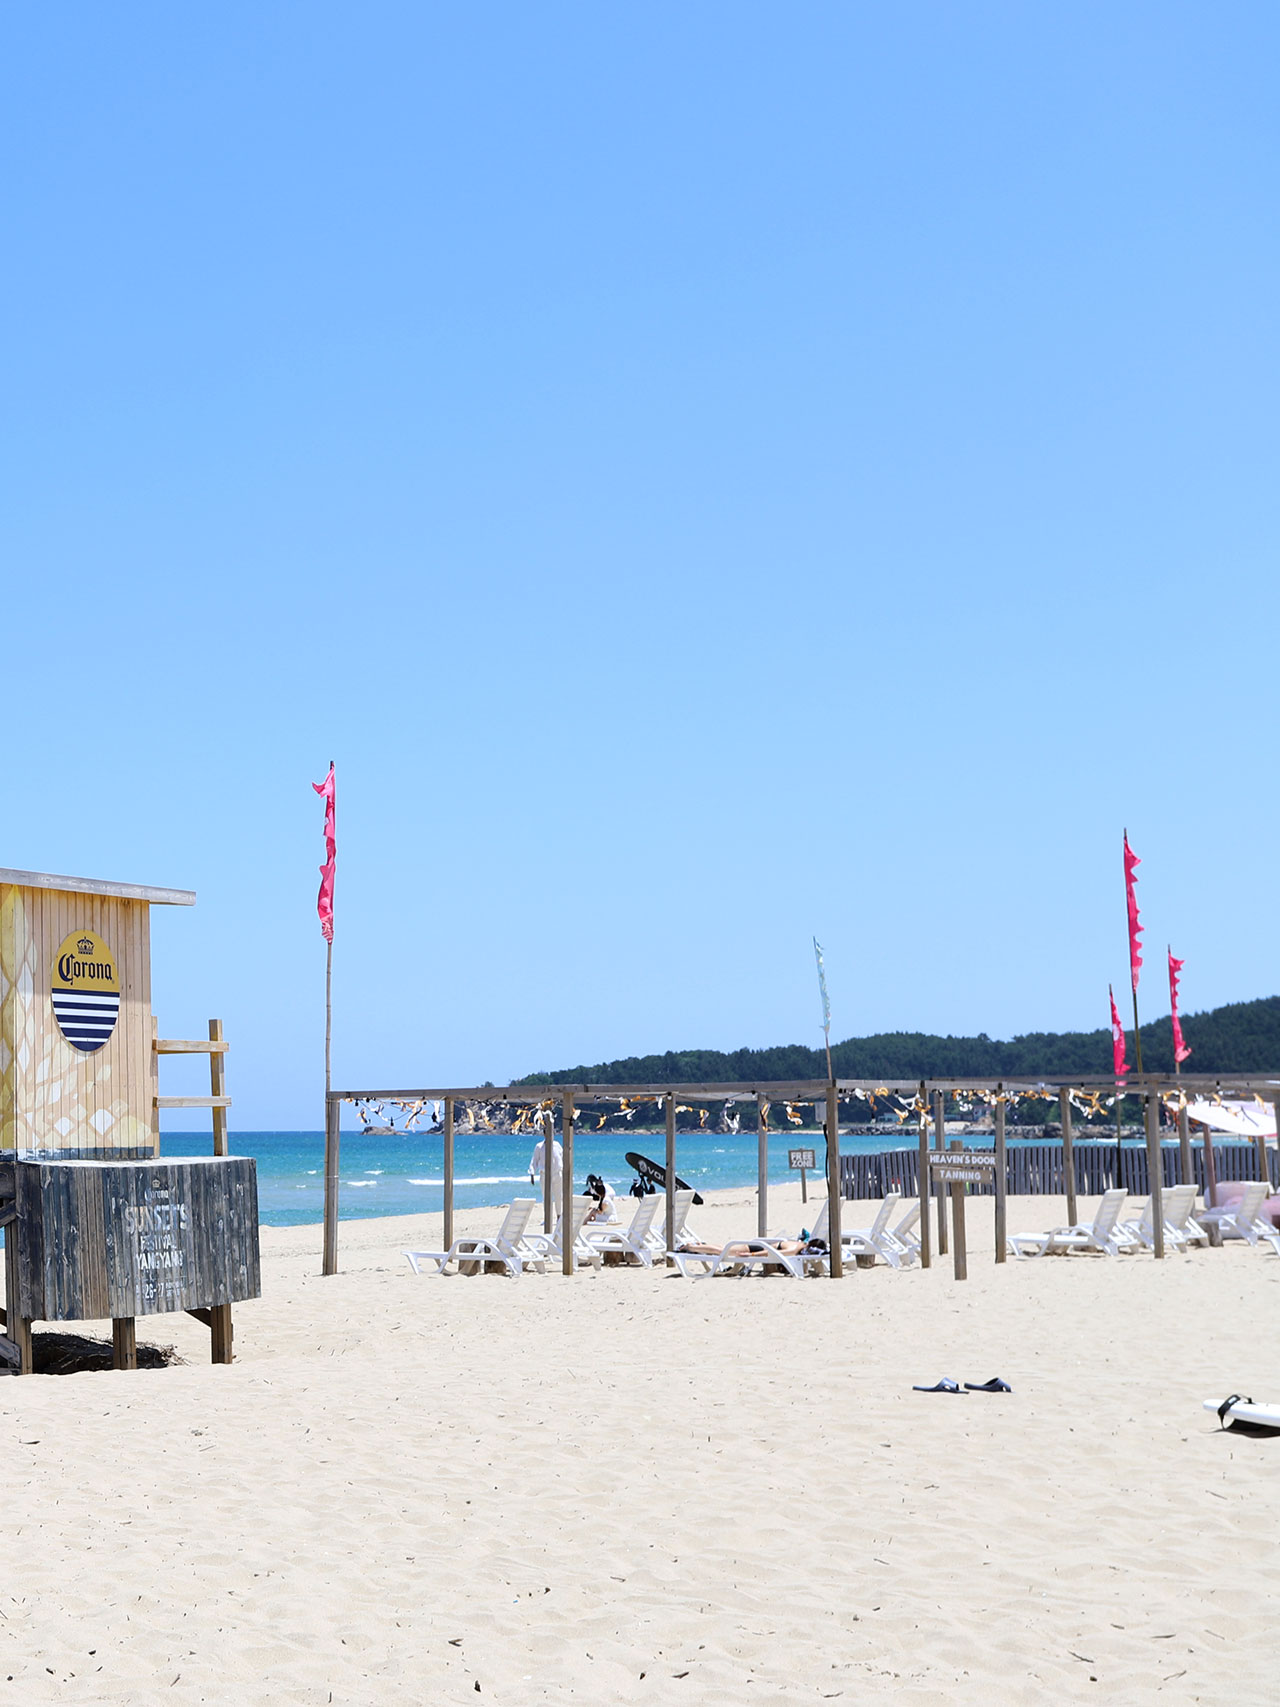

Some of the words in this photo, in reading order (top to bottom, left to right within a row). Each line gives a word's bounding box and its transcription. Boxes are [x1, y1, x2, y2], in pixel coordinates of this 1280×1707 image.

[58, 953, 112, 985] Corona
[790, 1151, 813, 1160] FREE
[929, 1154, 970, 1164] HEAVEN'S
[972, 1156, 996, 1165] DOOR
[791, 1160, 814, 1168] ZONE
[940, 1169, 981, 1181] TANNING
